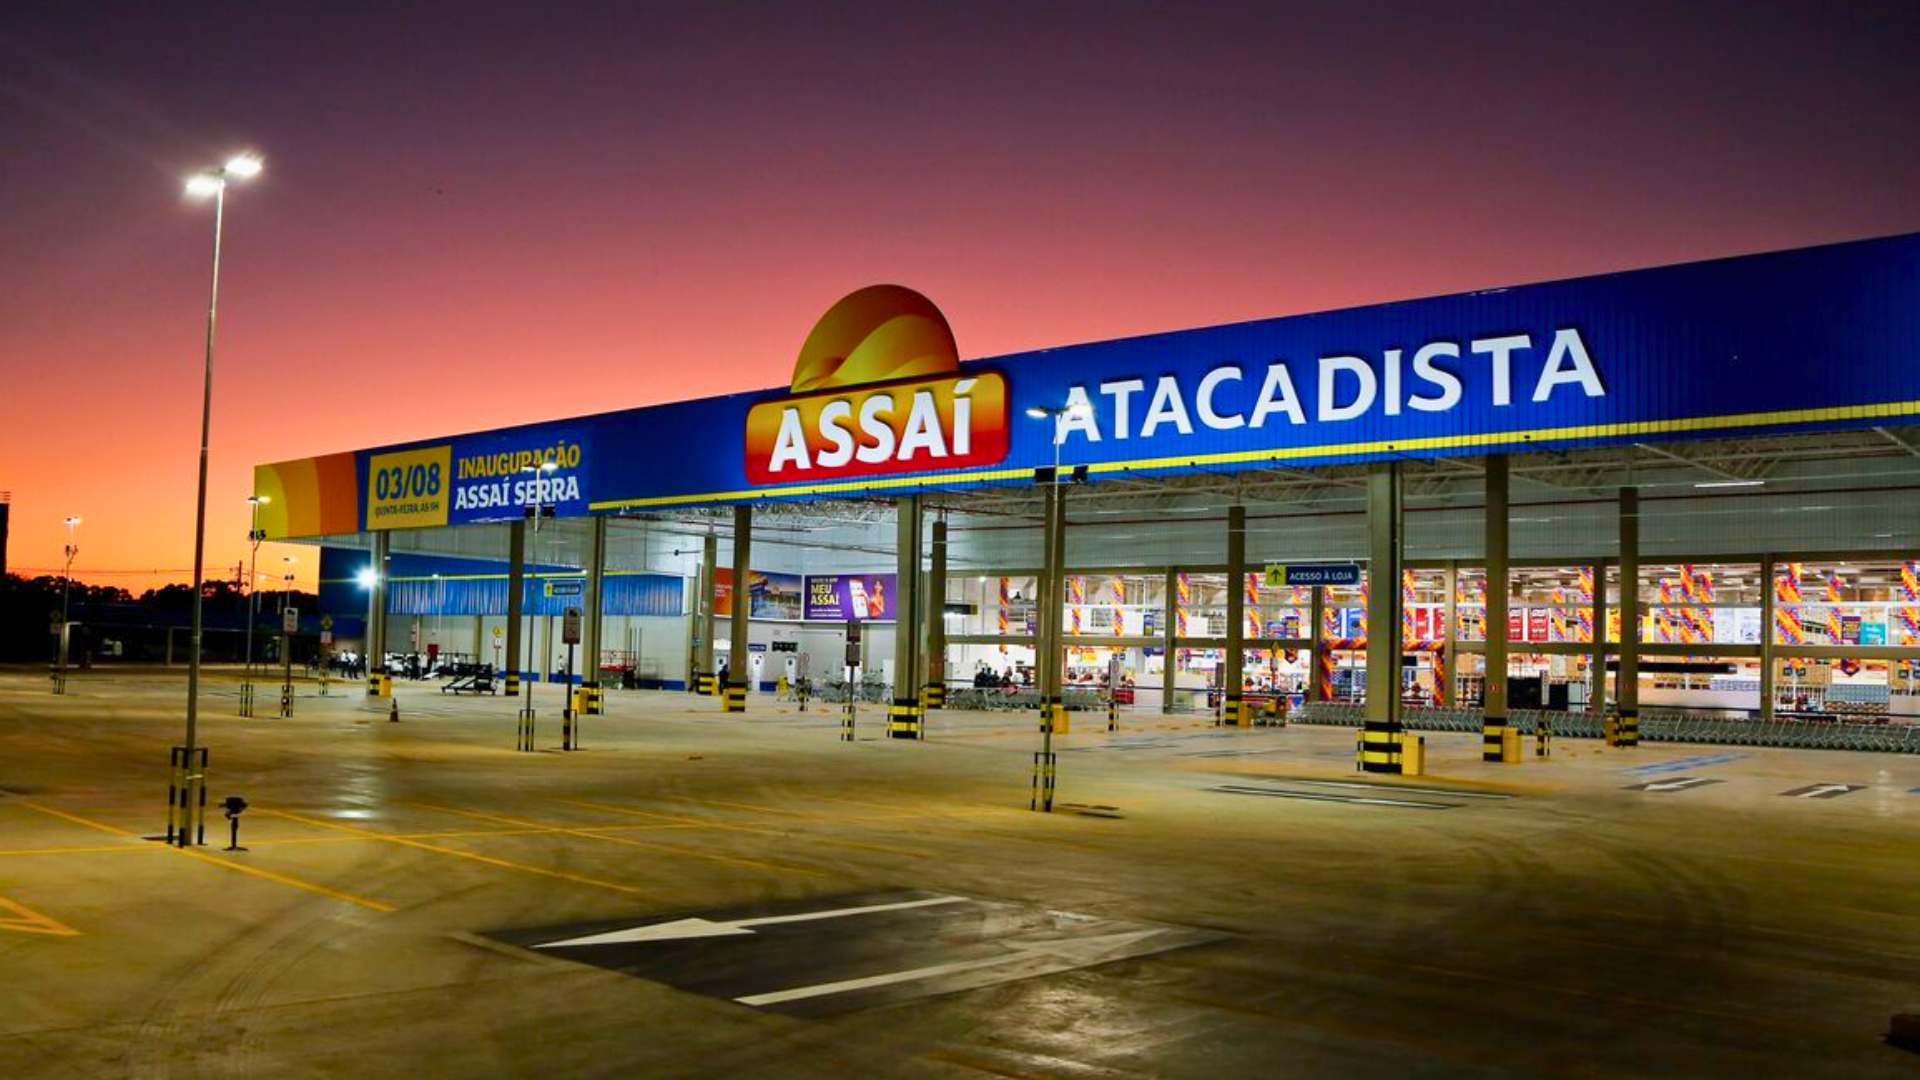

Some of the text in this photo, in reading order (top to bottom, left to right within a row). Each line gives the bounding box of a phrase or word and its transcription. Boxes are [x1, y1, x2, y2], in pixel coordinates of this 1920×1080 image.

[1053, 328, 1606, 445] ATACADISTA
[768, 378, 978, 473] ASSAÍ
[376, 462, 440, 501] 03/08
[455, 476, 580, 510] ASSAÍ SERRA
[811, 584, 832, 594] MEU
[1289, 572, 1322, 581] ACESSO
[1331, 572, 1354, 581] LOJA
[811, 592, 840, 605] ASSAÍ
